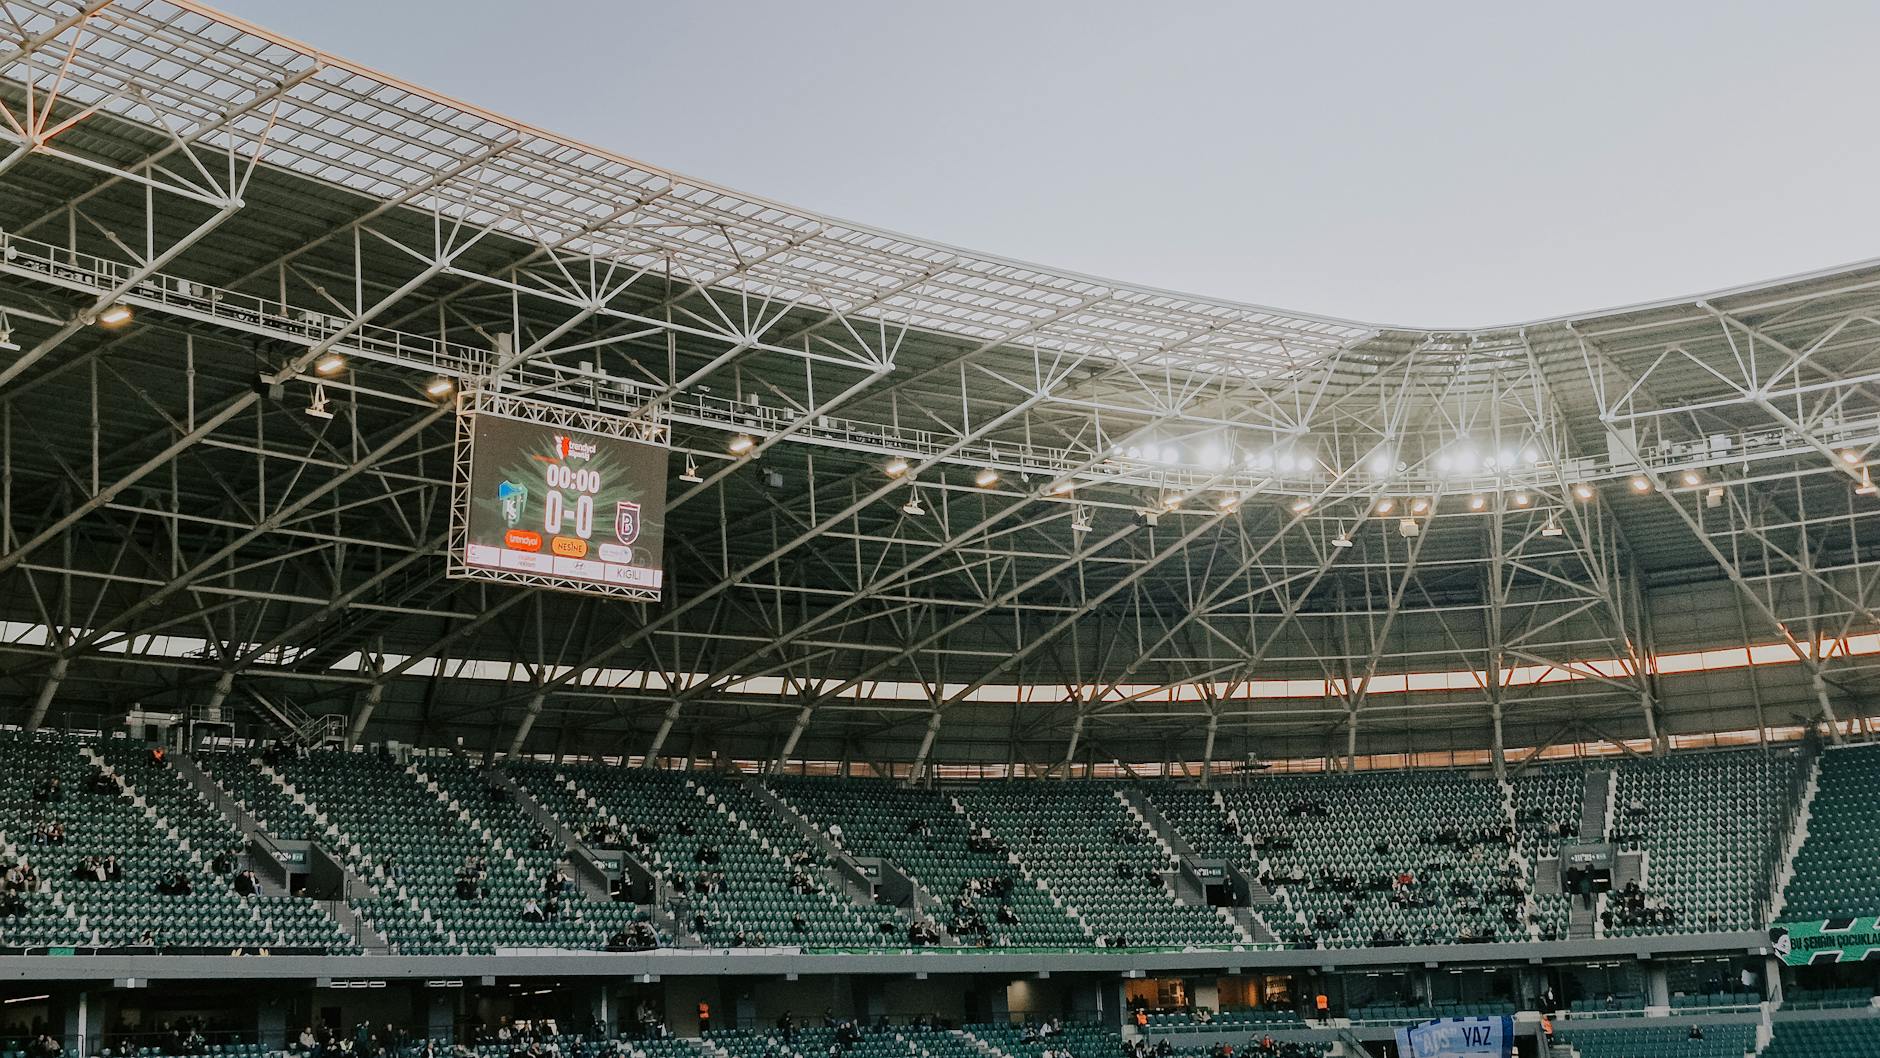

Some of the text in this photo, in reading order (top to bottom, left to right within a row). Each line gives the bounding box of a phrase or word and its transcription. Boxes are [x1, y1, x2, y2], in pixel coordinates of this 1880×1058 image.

[547, 464, 600, 494] 00:00
[509, 535, 539, 547] trendyol
[1791, 937, 1802, 950] BU
[1462, 1026, 1492, 1047] YAZ
